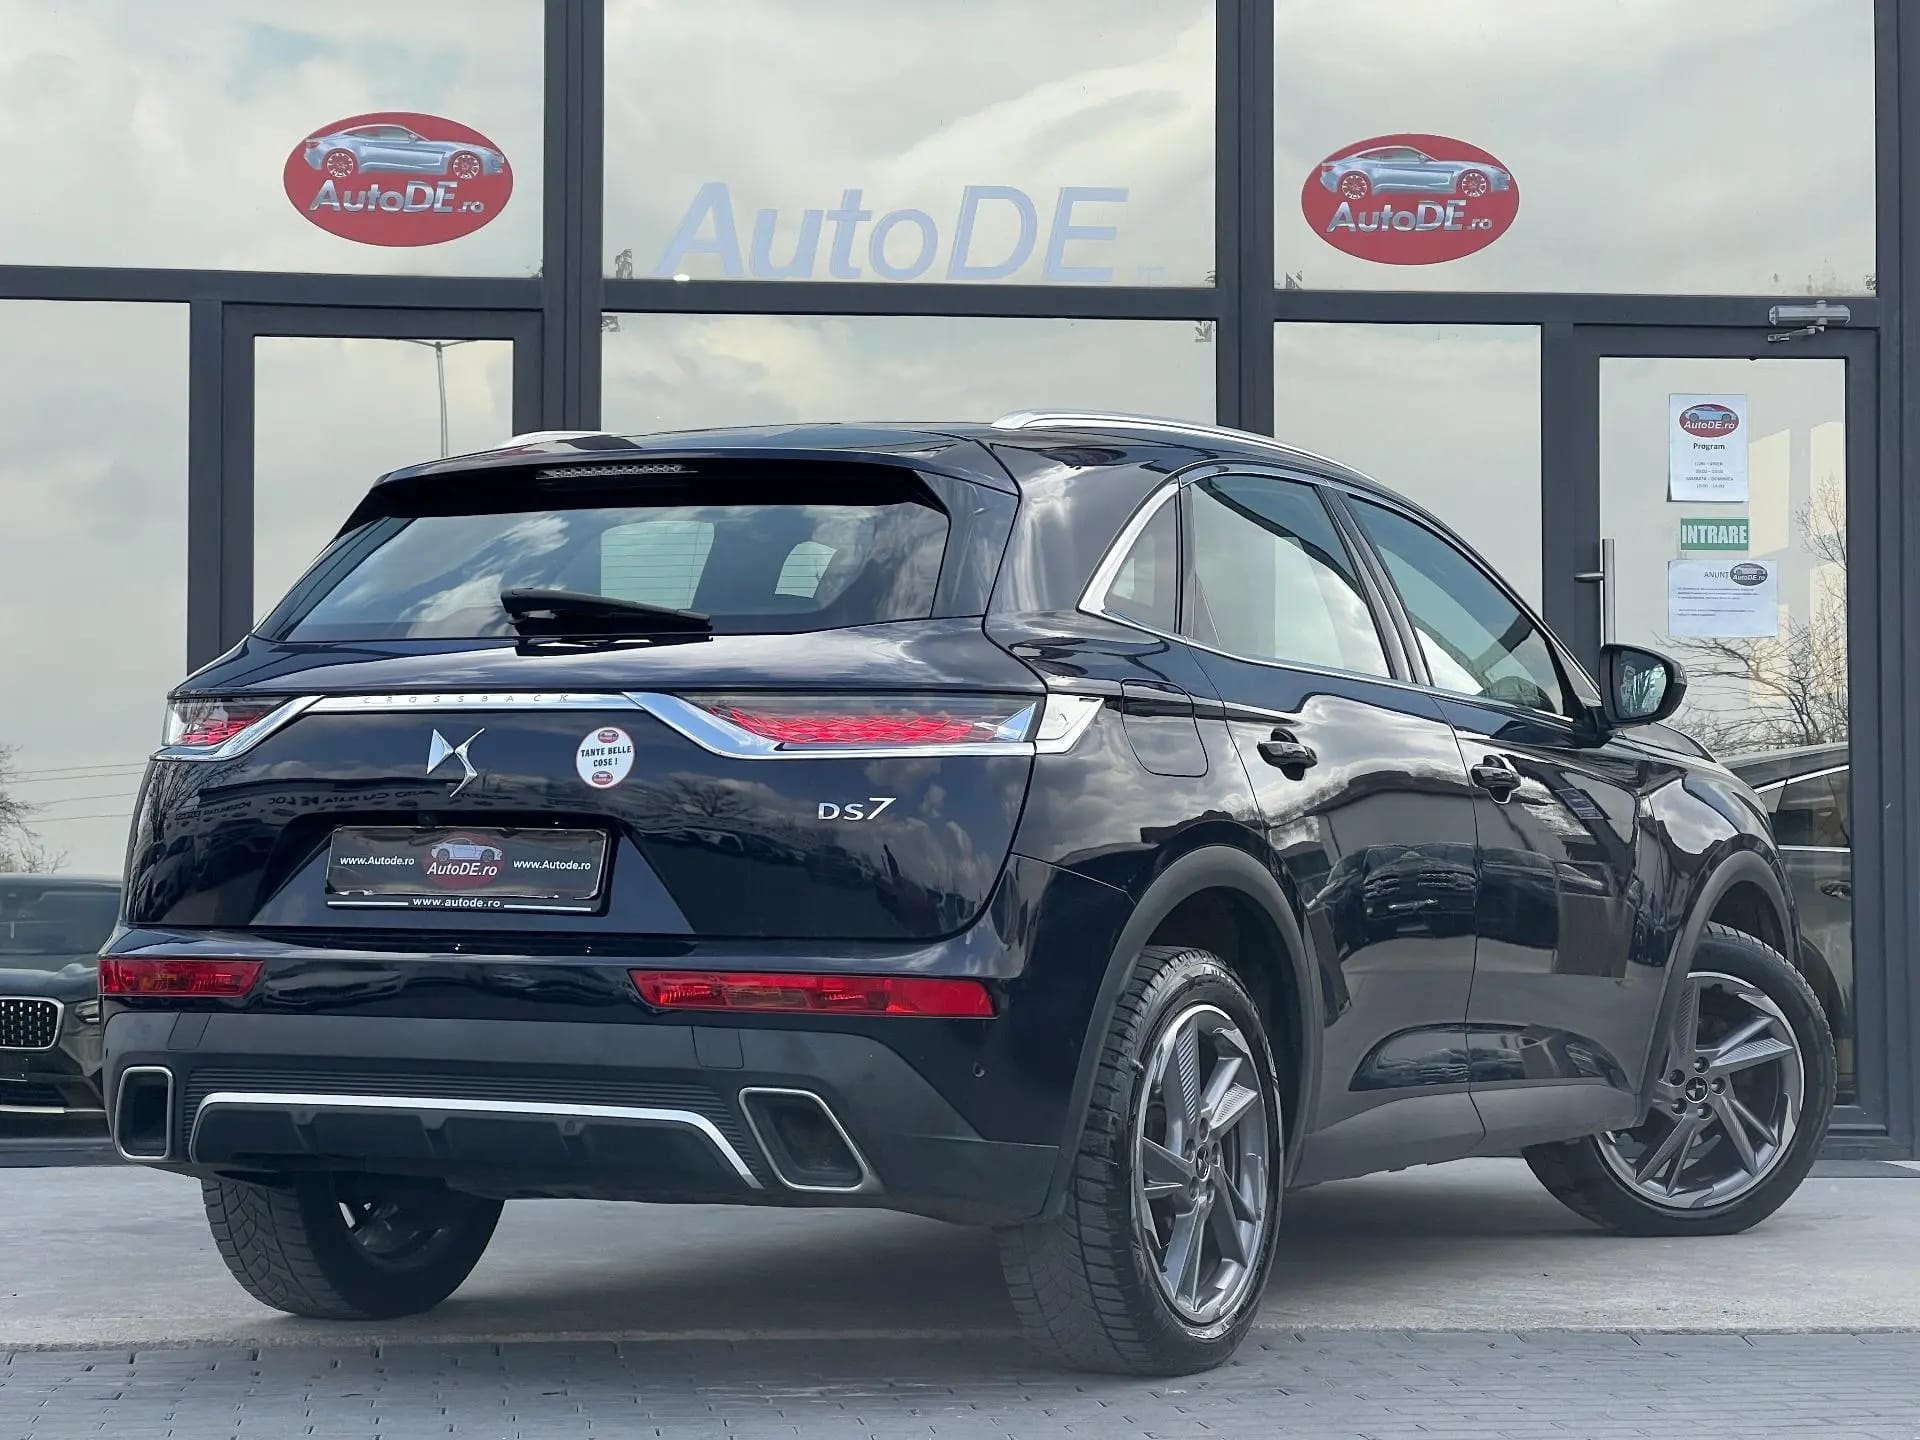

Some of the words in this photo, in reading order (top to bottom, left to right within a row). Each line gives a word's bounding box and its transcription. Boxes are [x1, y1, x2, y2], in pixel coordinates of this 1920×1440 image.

[652, 182, 1129, 283] AutoDE
[1683, 420, 1735, 430] AutoDE.ro
[1693, 442, 1726, 451] Program
[1681, 524, 1748, 544] INTRARE
[363, 694, 569, 705] CROSSBACK
[580, 747, 605, 758] TANTE
[607, 745, 632, 755] BELLE
[593, 757, 613, 767] COSE
[818, 797, 897, 821] DS7
[339, 855, 415, 866] www.Autode.ro
[513, 859, 591, 871] www.Autode.ro
[426, 862, 498, 877] AutoDE.ro
[412, 897, 501, 908] www.autode.ro
